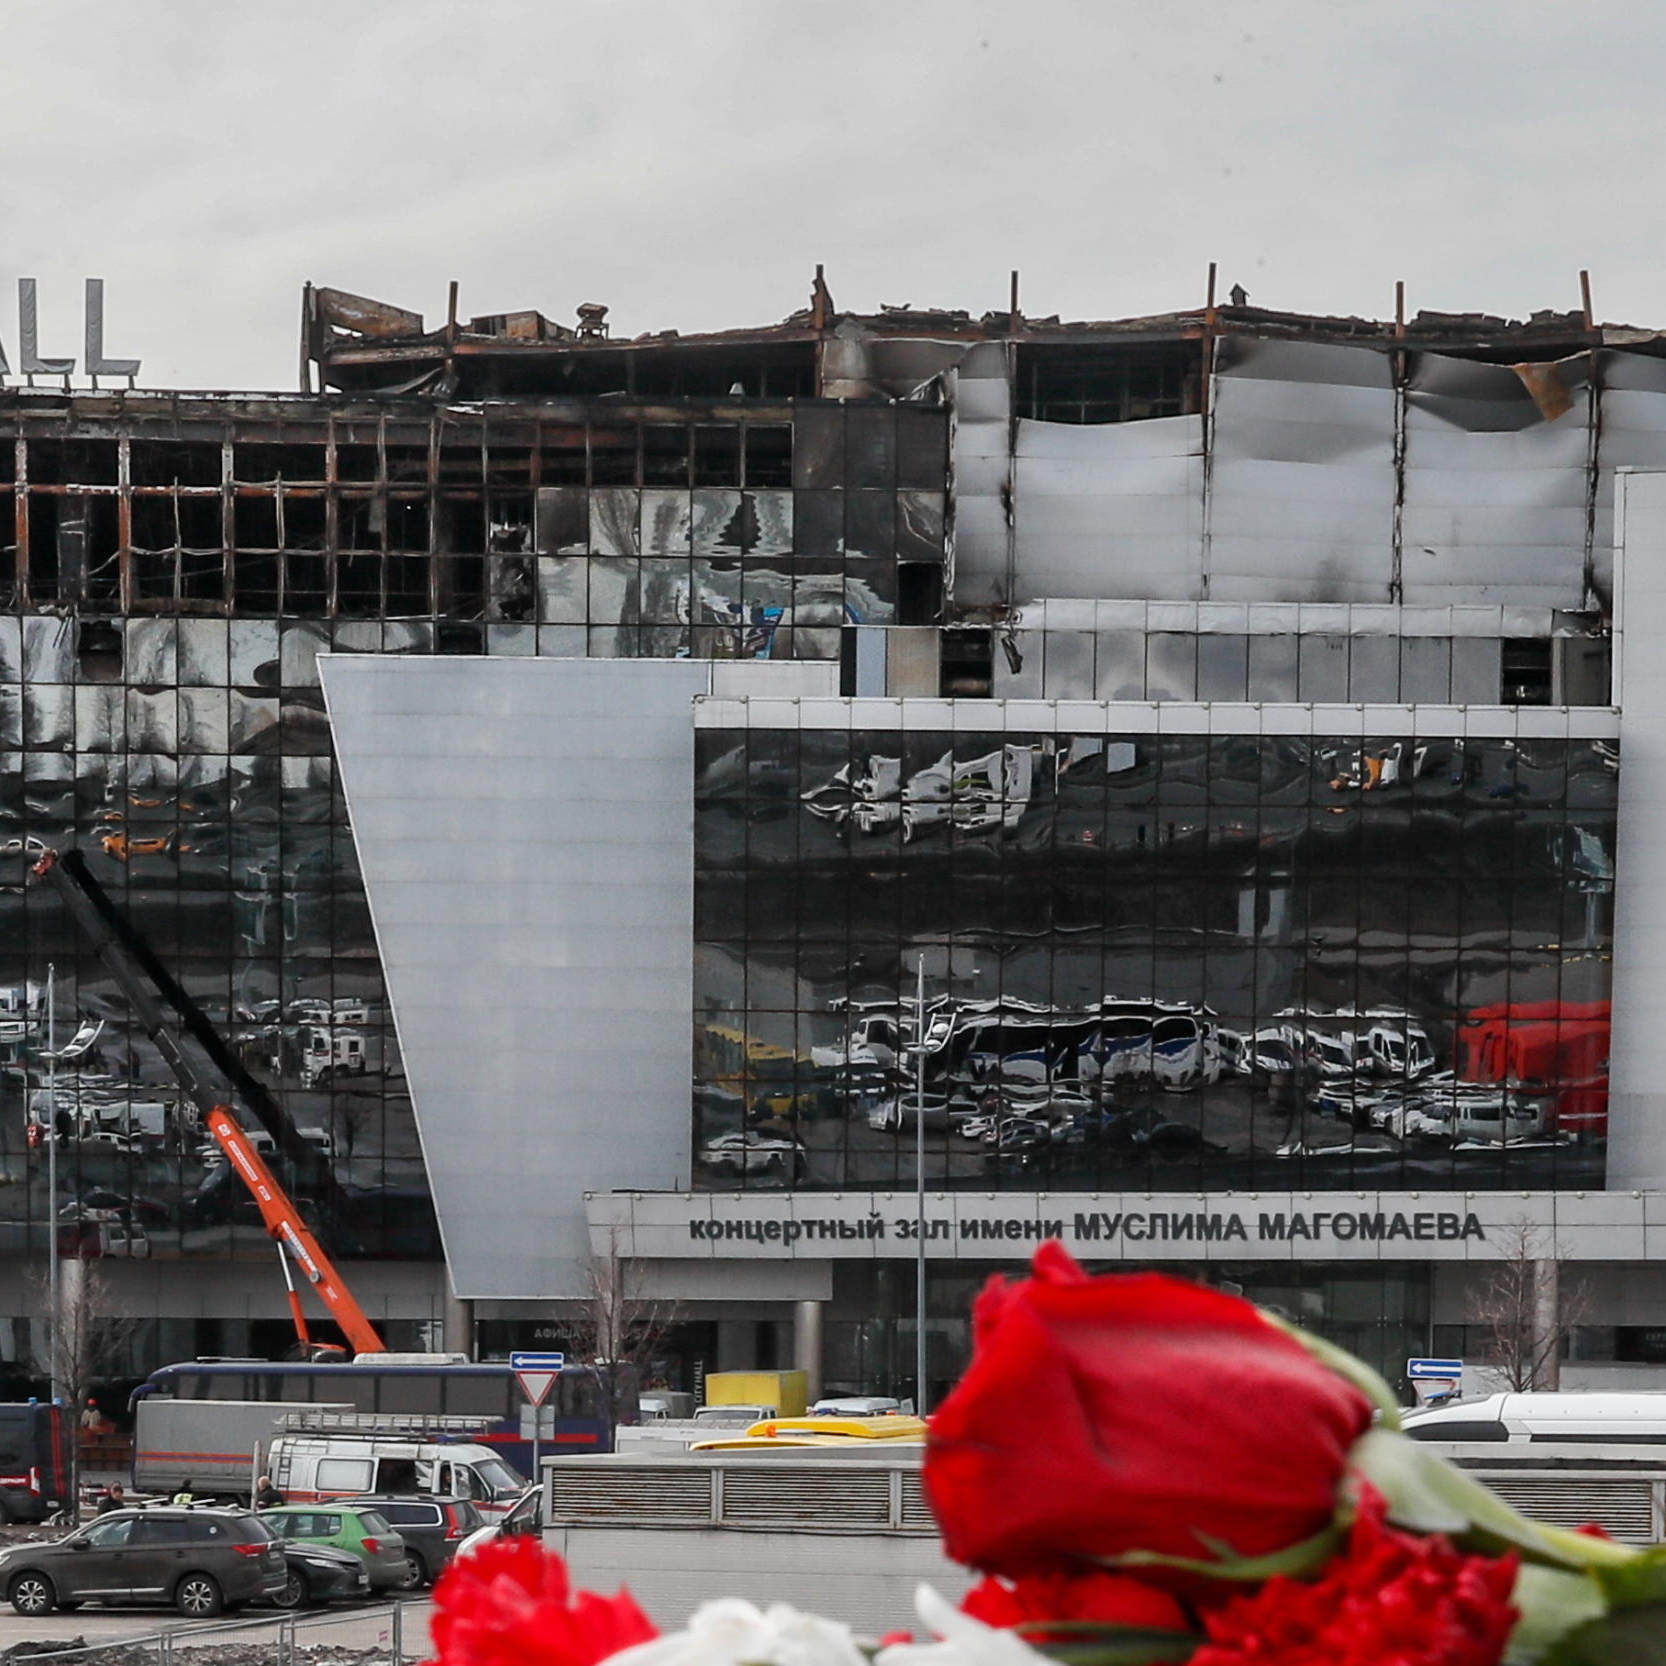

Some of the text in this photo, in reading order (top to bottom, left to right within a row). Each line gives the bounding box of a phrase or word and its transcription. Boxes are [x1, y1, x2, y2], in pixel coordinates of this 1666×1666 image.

[689, 1212, 1486, 1246] концертный зал имени МУСЛИМА МАГОМАЕВА
[534, 1327, 581, 1339] АФИША
